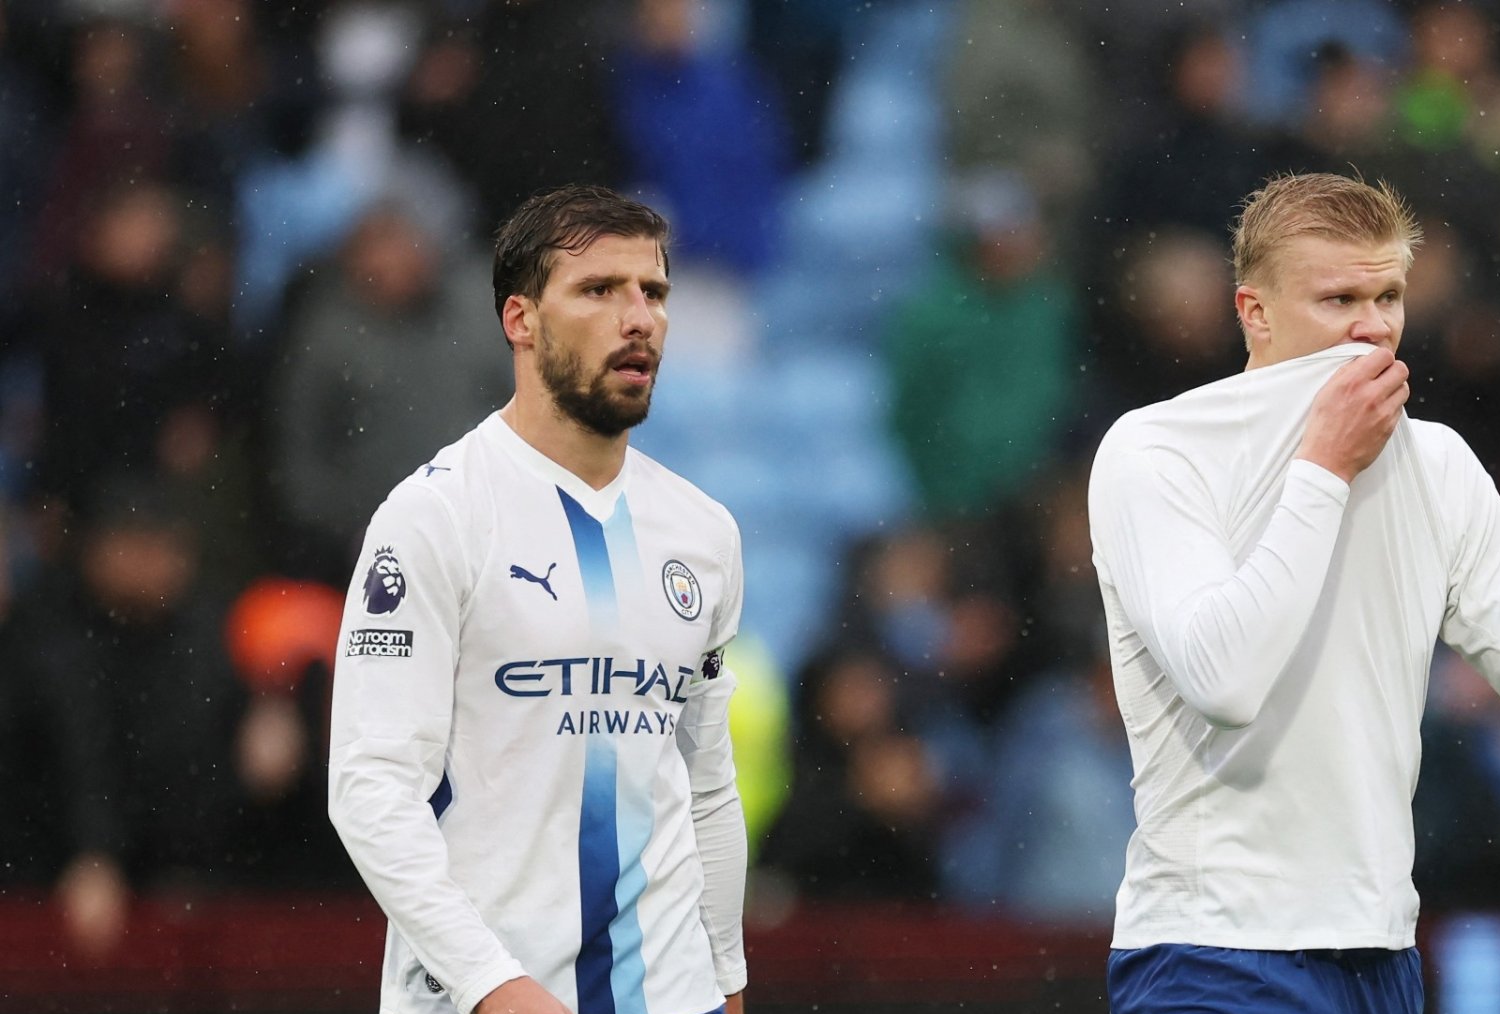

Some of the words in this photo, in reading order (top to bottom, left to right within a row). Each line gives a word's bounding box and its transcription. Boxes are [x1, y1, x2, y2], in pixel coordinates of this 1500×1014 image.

[365, 631, 406, 645] room
[363, 643, 412, 657] racism
[556, 709, 676, 736] AIRWAYS
